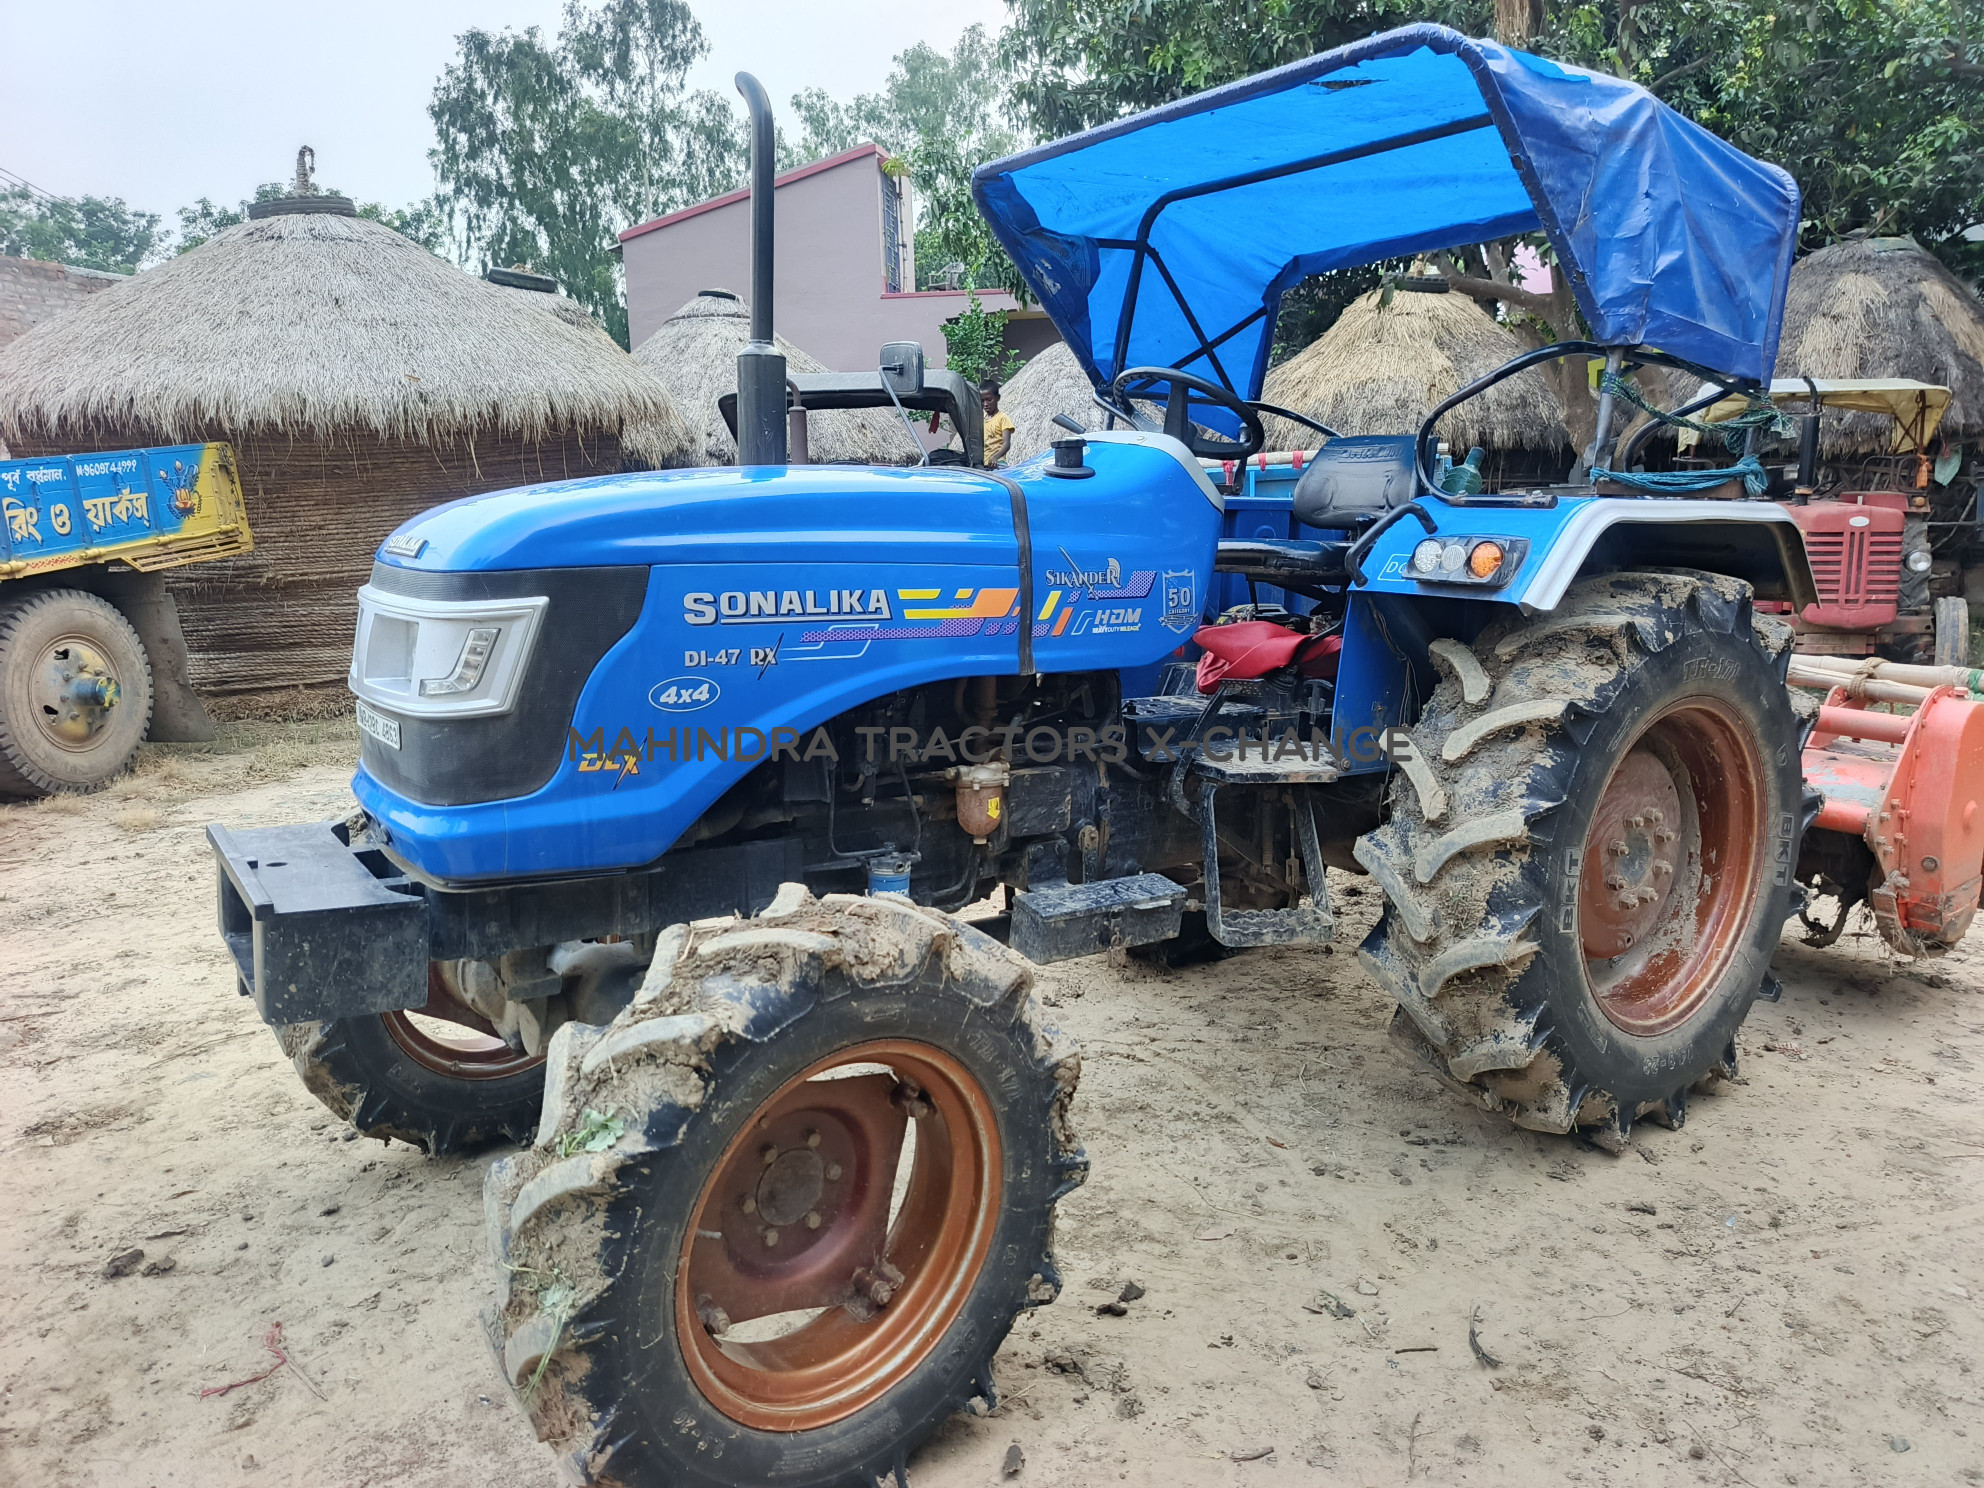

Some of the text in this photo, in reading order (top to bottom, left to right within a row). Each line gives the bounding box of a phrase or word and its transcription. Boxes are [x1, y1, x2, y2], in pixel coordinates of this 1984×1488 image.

[1045, 565, 1121, 588] SIKANDER
[683, 589, 891, 624] SONALIKA
[1168, 587, 1191, 607] 50
[1094, 608, 1142, 624] HDM
[684, 649, 741, 667] DI-47
[660, 684, 710, 705] 4x4
[1773, 813, 1796, 888] BKT
[1559, 848, 1582, 934] BKT
